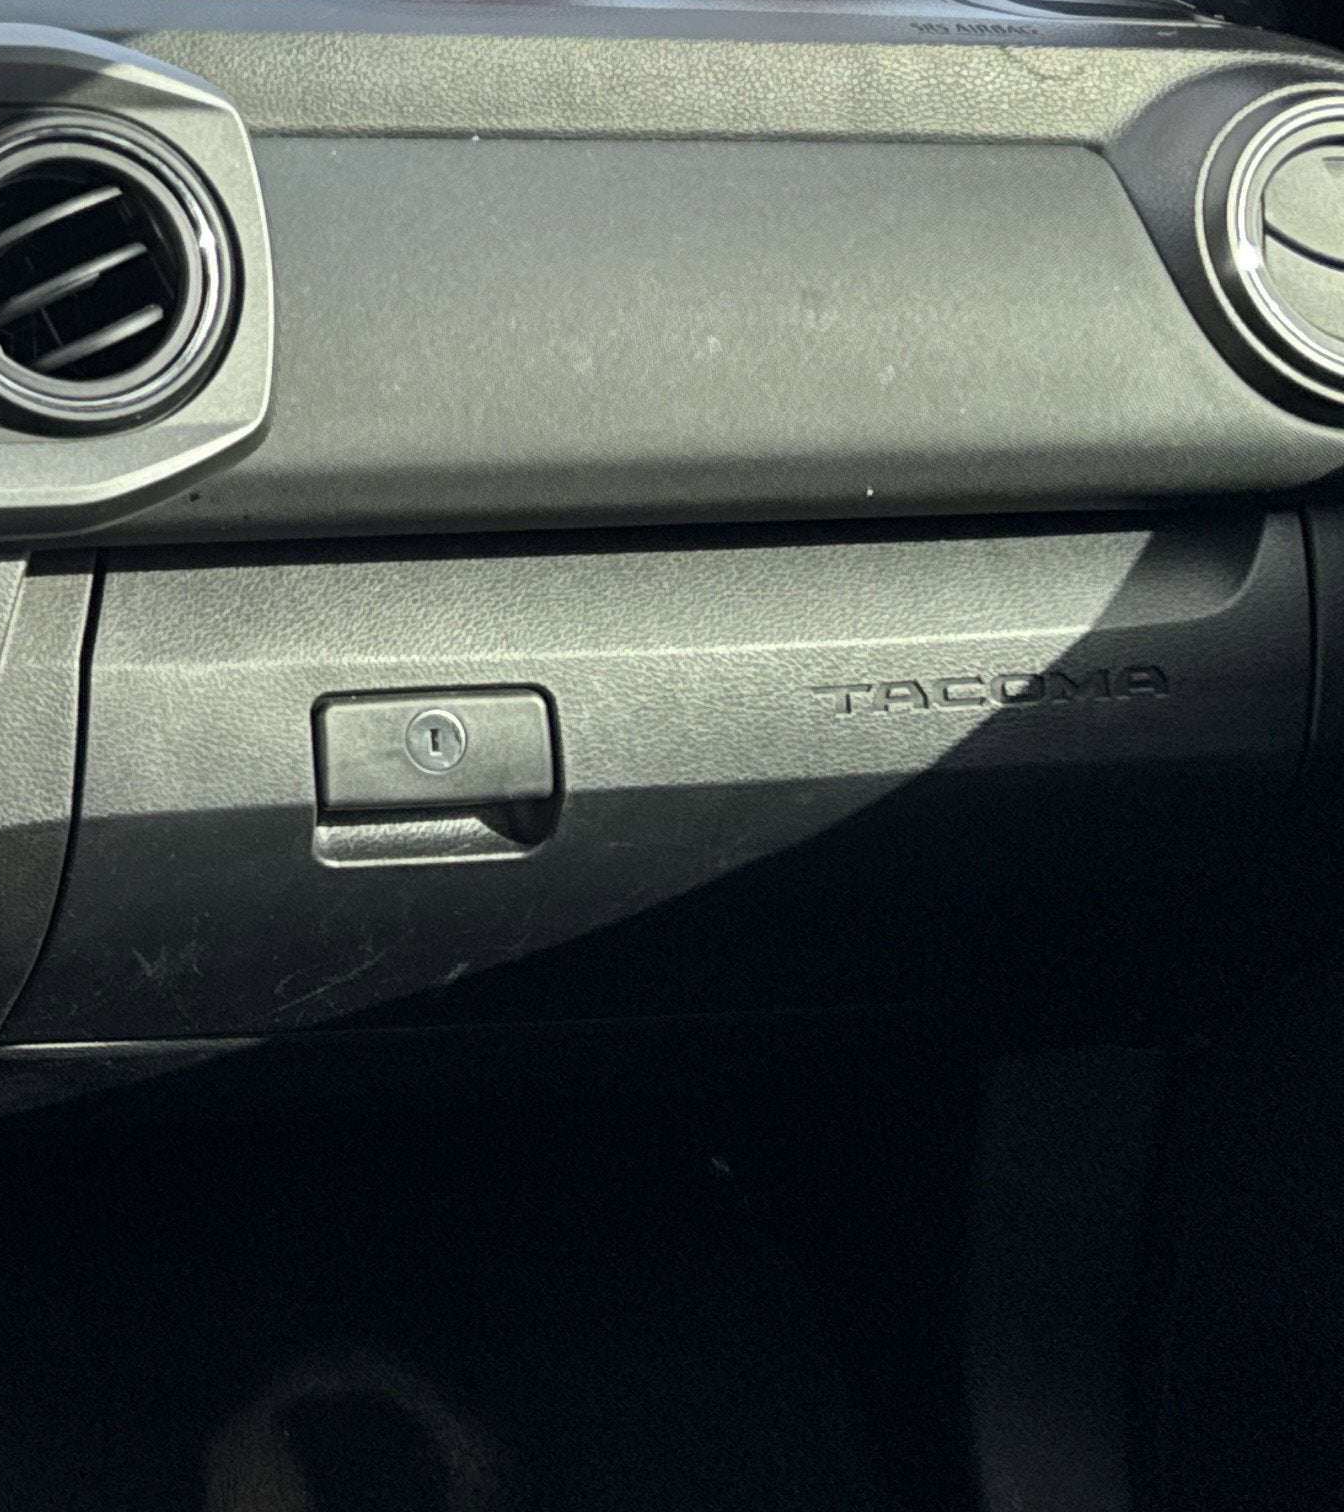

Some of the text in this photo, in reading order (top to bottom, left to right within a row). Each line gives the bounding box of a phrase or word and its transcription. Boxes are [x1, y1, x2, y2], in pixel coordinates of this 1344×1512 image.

[910, 22, 1038, 35] SRS AIRBAG
[811, 665, 1170, 718] TACOMA
